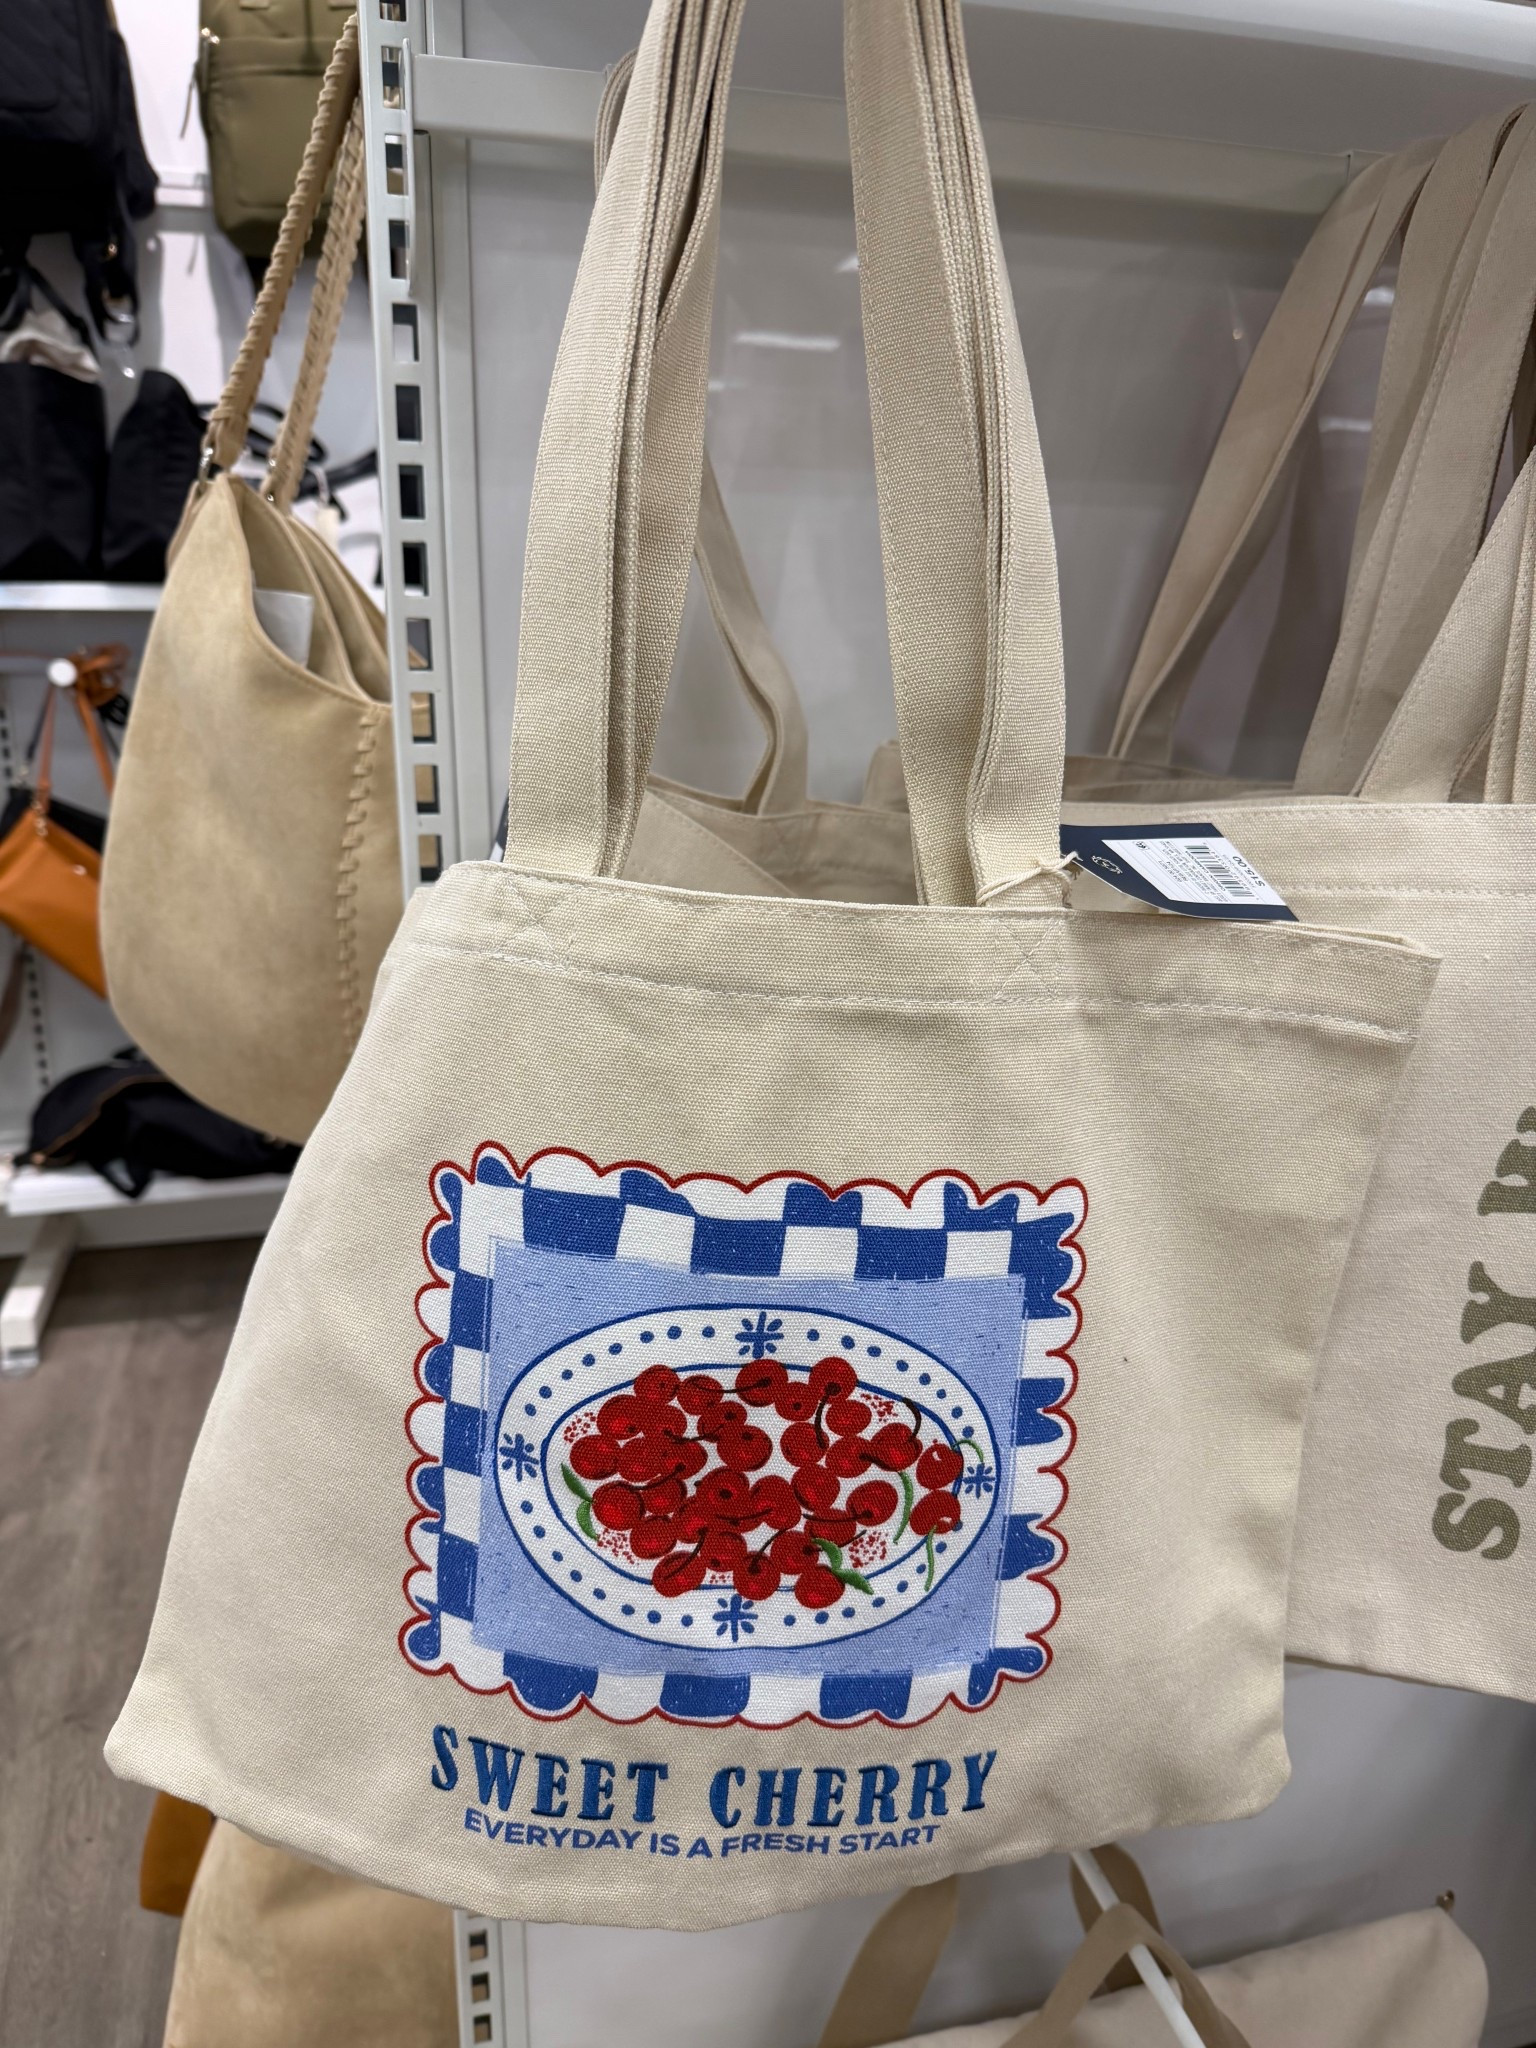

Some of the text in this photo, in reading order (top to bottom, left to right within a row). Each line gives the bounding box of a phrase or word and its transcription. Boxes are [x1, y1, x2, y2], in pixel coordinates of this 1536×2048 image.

[1232, 856, 1265, 887] $15.00
[1431, 1261, 1536, 1561] STAY
[432, 1724, 998, 1829] SWEET CHERRY
[464, 1807, 941, 1858] EVERYDAY IS A FRESH START
